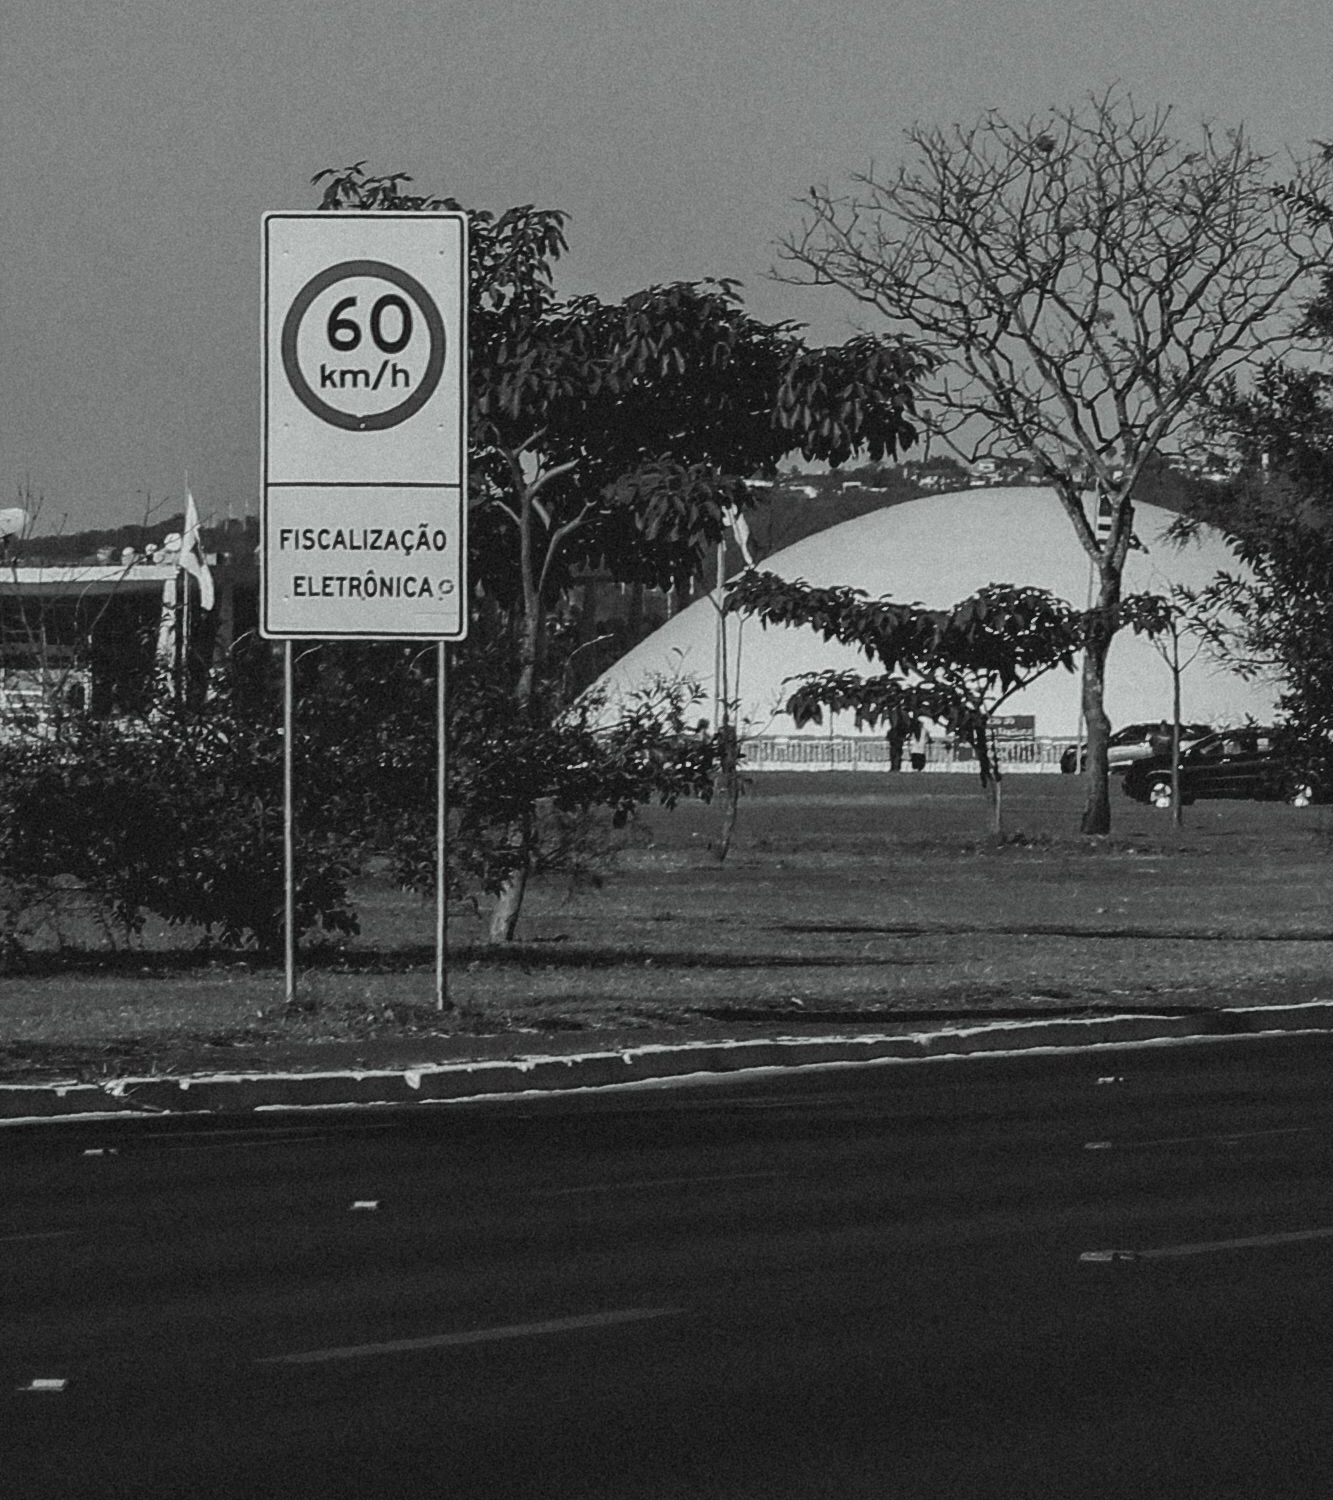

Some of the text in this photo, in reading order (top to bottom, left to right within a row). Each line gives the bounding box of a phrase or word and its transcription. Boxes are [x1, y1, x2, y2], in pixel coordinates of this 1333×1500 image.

[327, 294, 412, 353] 60
[320, 359, 409, 390] km/h
[280, 523, 446, 556] FISCALIZAÇÃO
[293, 570, 433, 598] ELETRÔNICA
